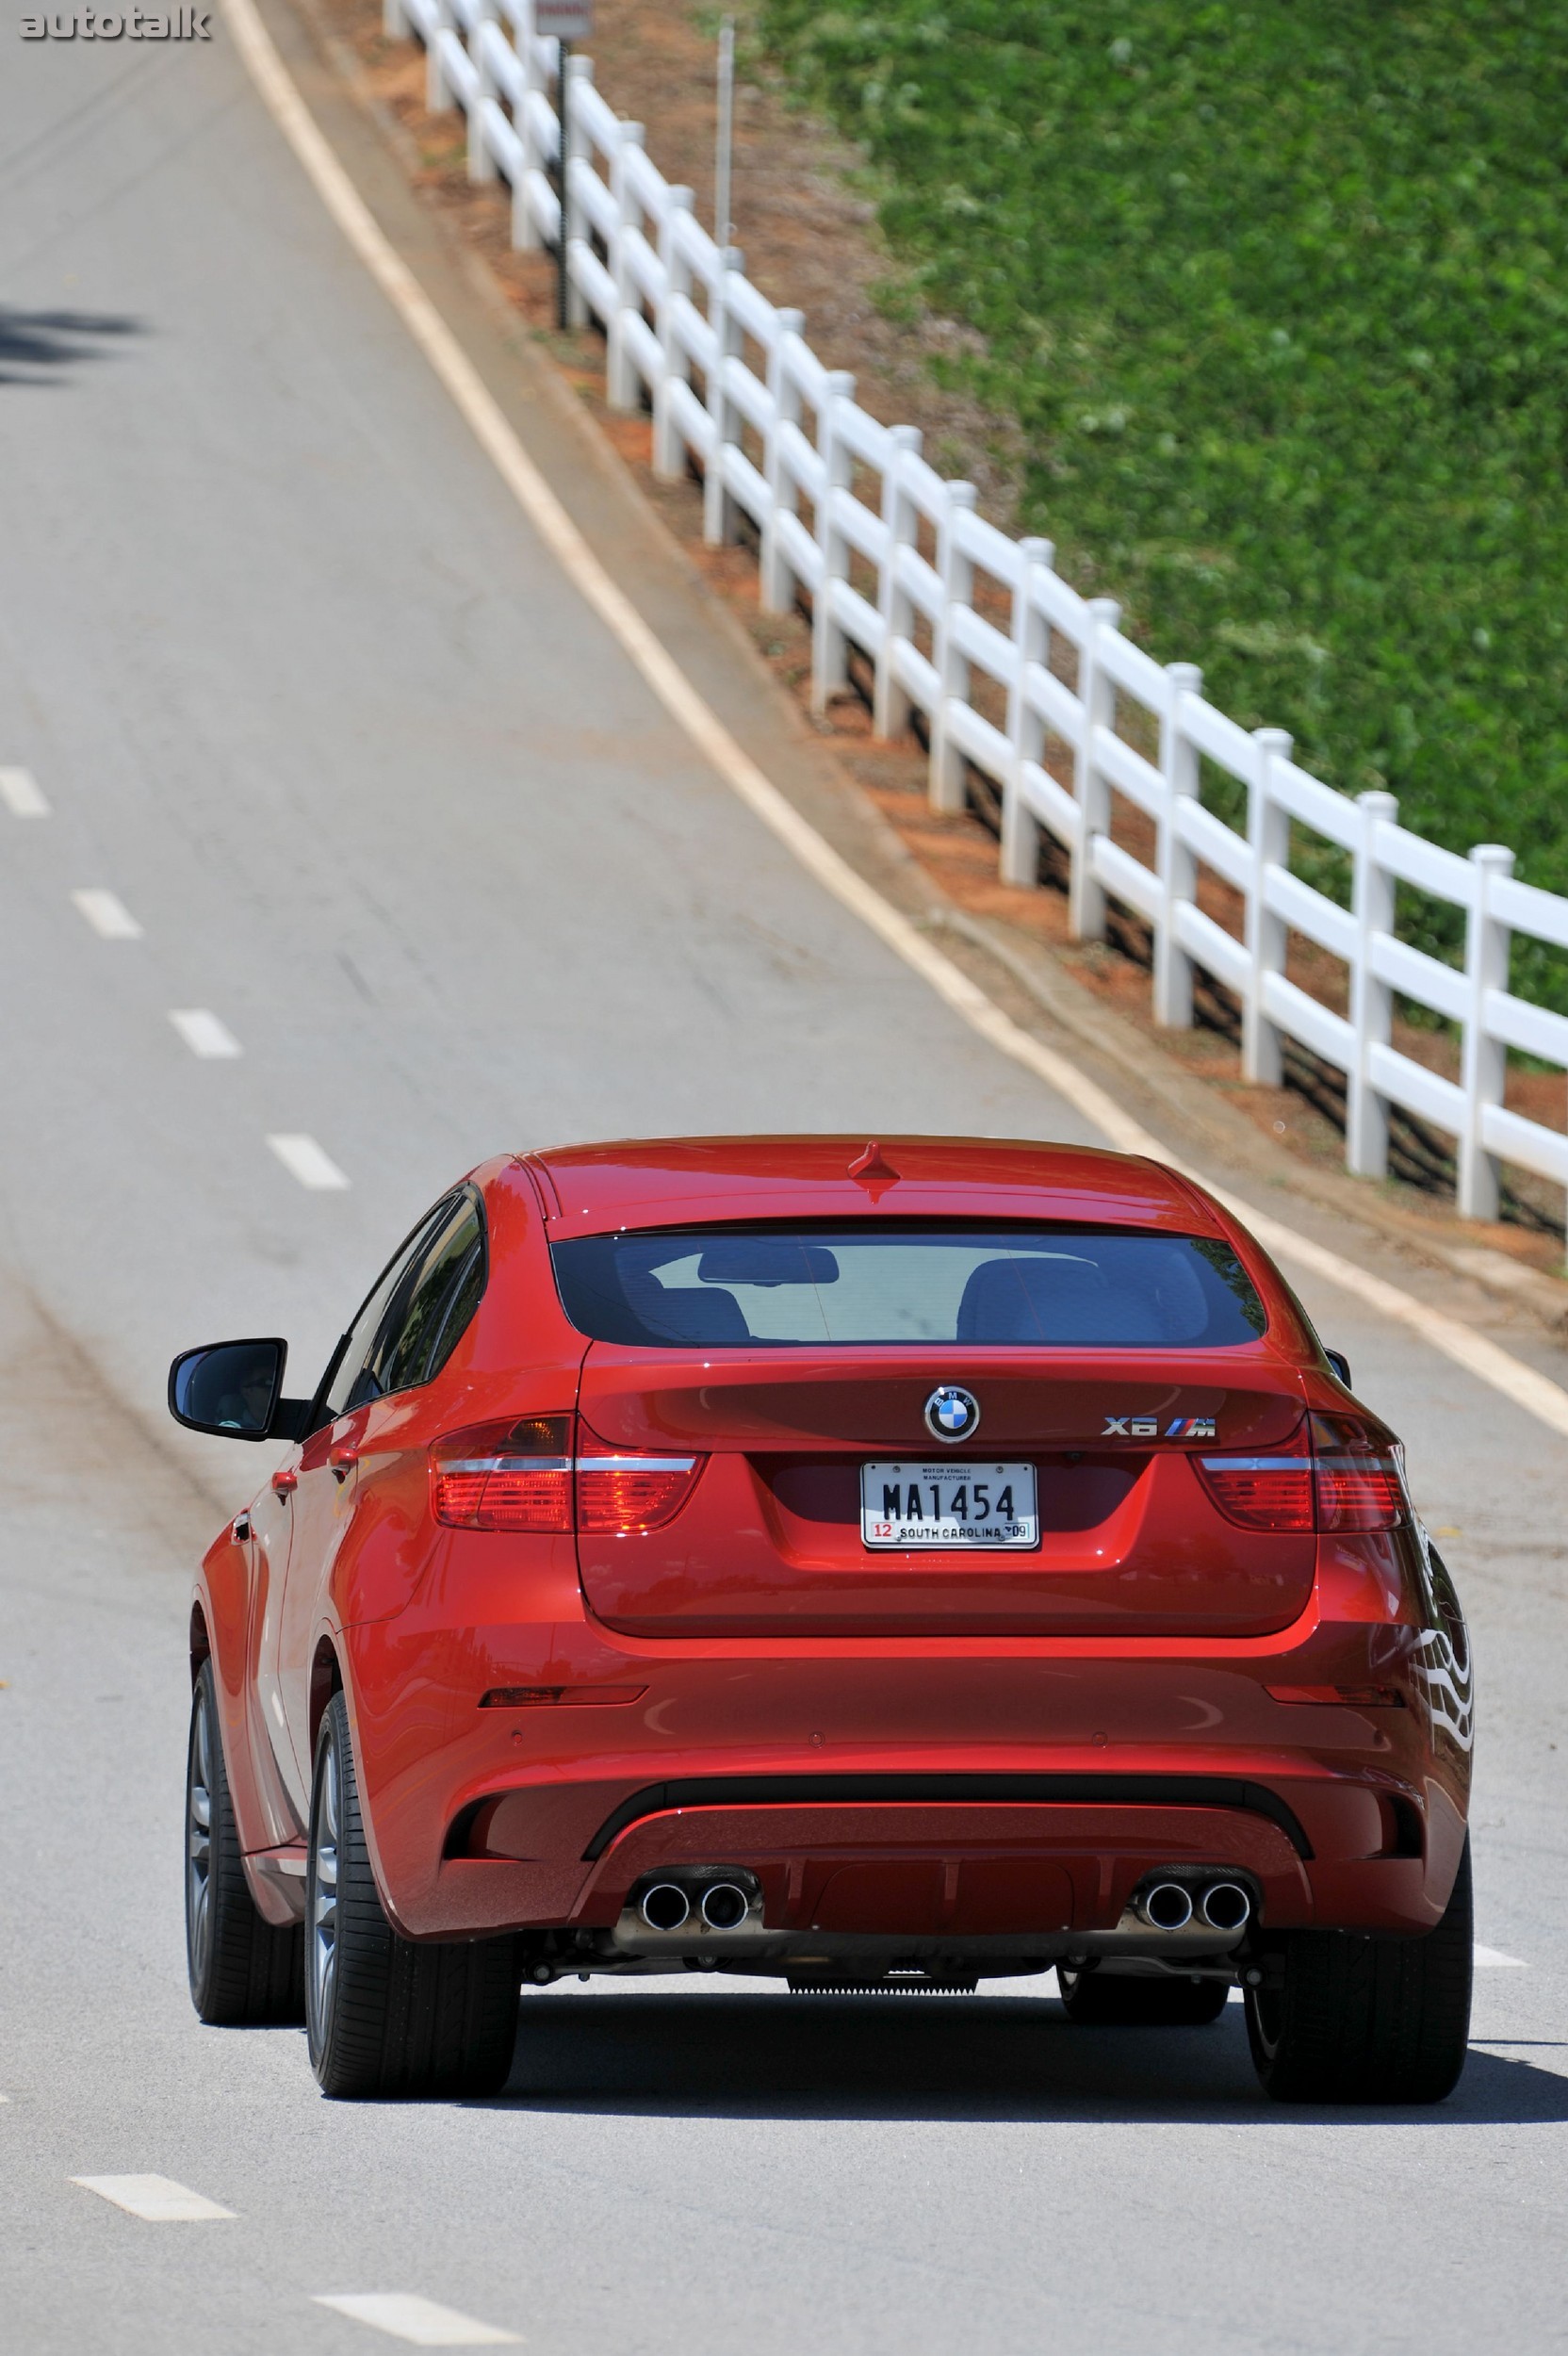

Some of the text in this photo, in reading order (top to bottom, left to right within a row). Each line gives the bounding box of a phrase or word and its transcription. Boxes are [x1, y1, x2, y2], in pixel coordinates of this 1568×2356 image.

[935, 1392, 972, 1407] BMW
[1101, 1417, 1158, 1436] X6
[883, 1484, 1014, 1520] MA1454
[874, 1524, 891, 1537] 12
[900, 1528, 1001, 1538] SOUTH CAROLINA
[1012, 1525, 1026, 1537] 09
